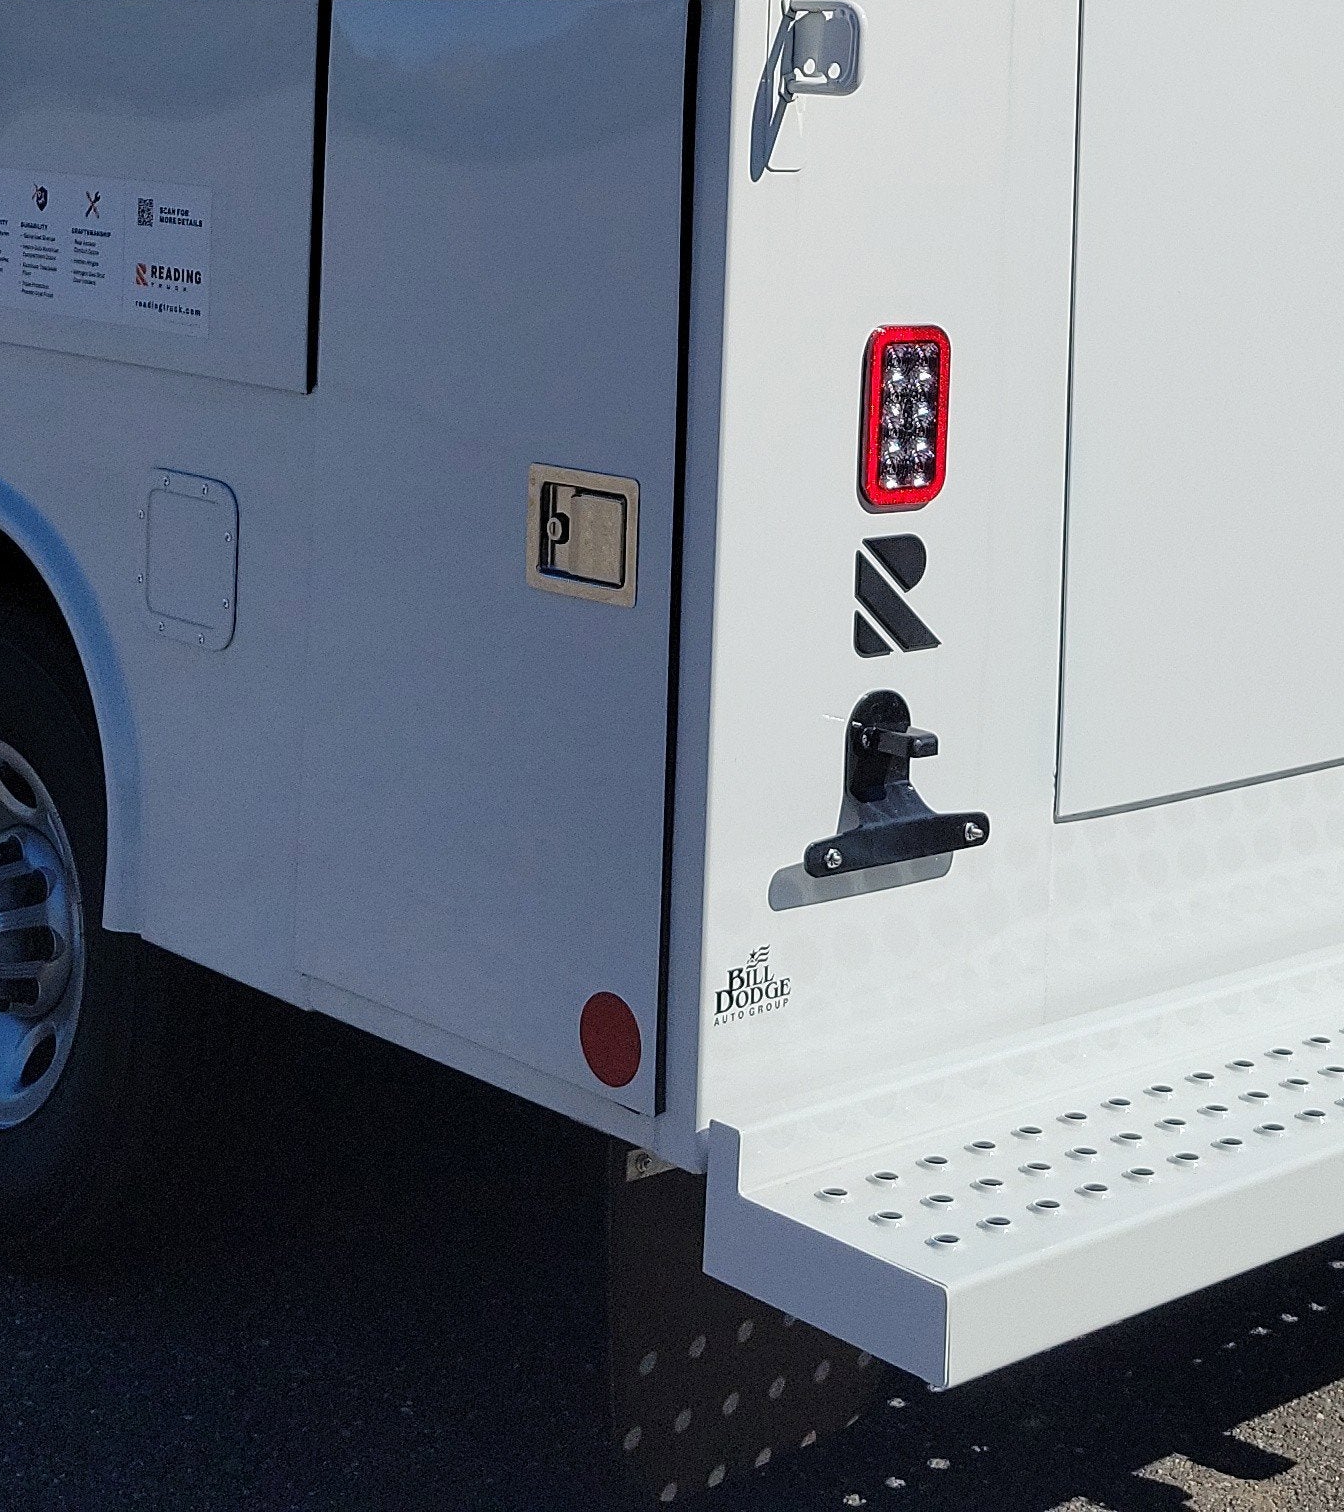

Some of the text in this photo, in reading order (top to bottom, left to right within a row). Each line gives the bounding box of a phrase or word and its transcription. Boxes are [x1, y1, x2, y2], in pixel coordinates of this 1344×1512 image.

[159, 207, 176, 216] SCAN
[159, 216, 203, 227] MORE DETAILS
[151, 265, 202, 285] READING
[135, 300, 202, 317] readingtruck.com
[727, 965, 775, 992] BILL
[714, 978, 792, 1015] DODGE
[713, 997, 789, 1027] AUTO GROUP
